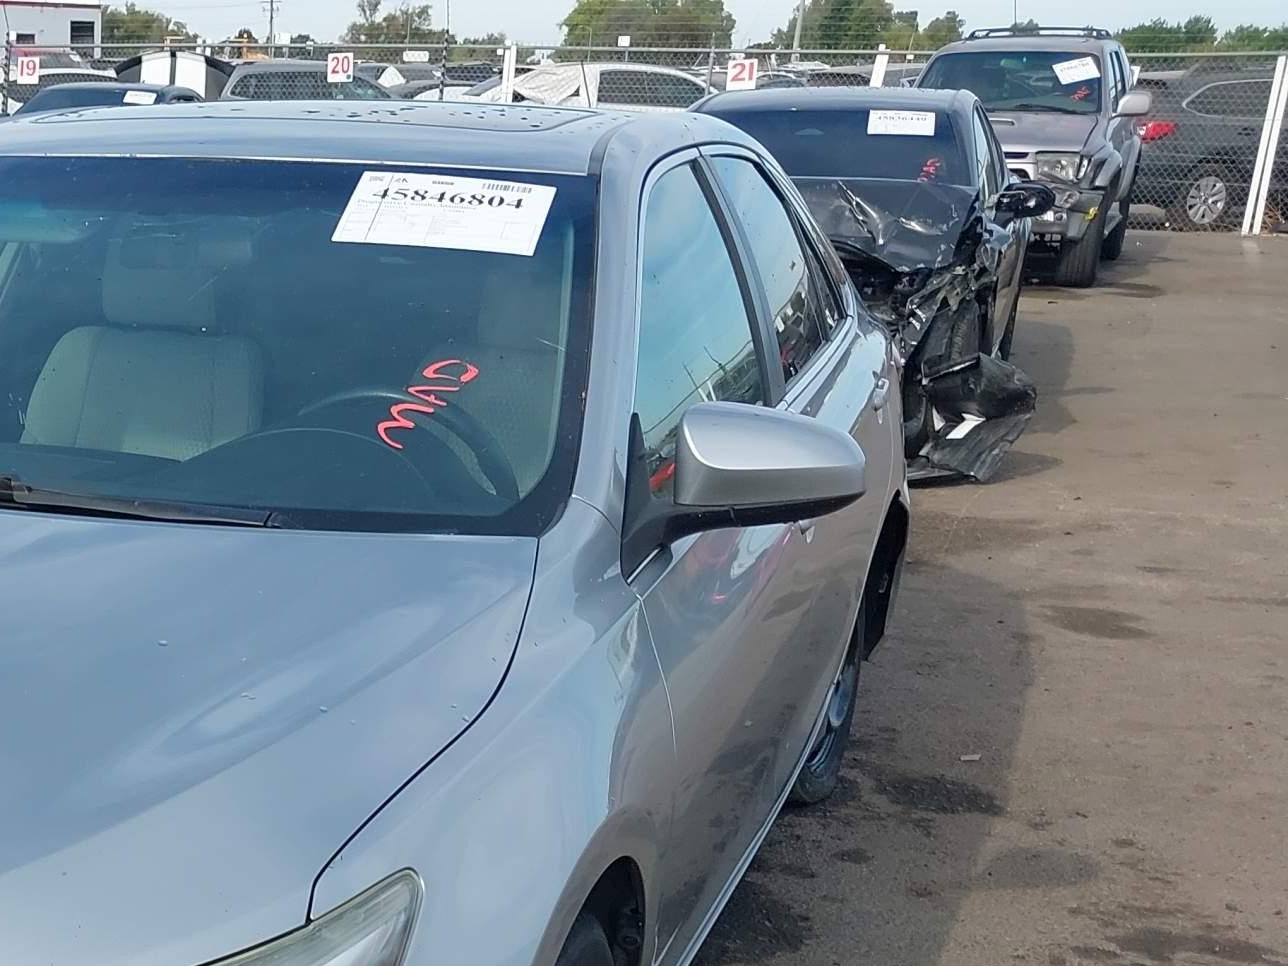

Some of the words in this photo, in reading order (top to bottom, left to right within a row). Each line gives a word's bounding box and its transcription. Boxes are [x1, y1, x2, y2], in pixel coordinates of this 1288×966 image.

[19, 59, 36, 76] 19
[330, 55, 350, 74] 20
[730, 62, 755, 81] 21
[372, 187, 524, 209] 45846804
